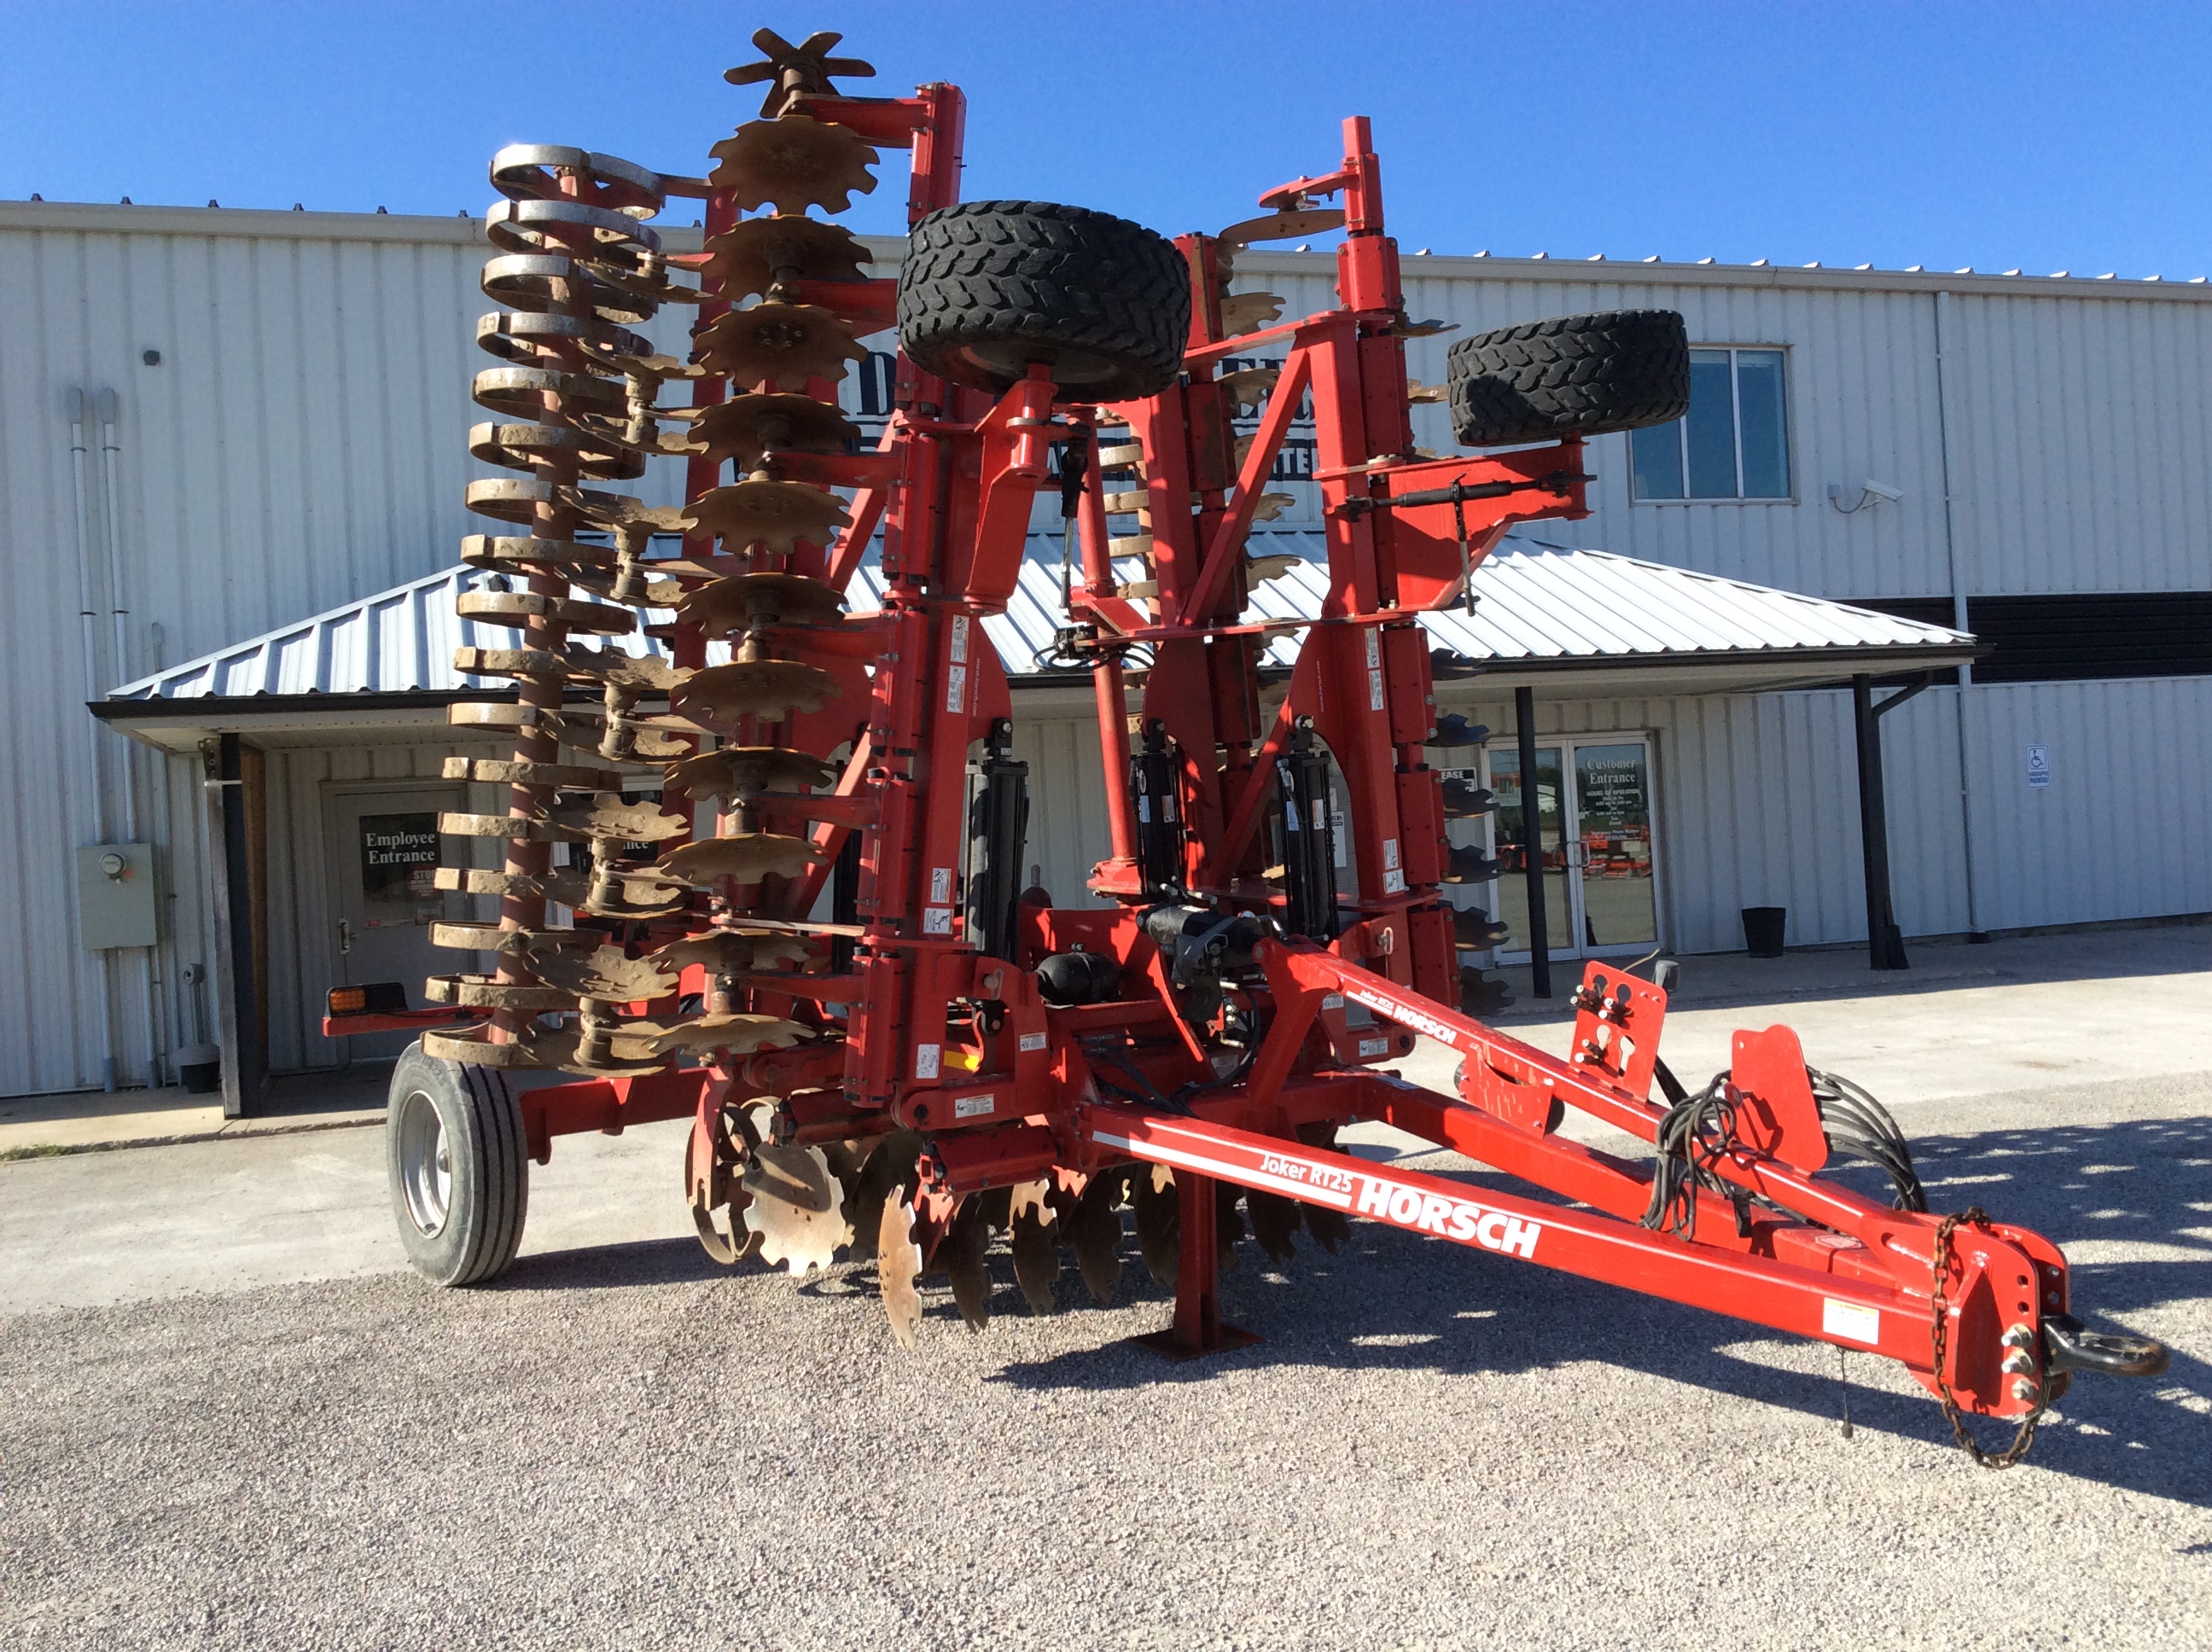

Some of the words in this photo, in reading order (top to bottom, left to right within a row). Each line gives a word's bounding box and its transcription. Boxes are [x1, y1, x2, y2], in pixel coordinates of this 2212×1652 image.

[1587, 758, 1636, 770] Customer
[1441, 771, 1464, 780] EASE
[1590, 772, 1636, 784] Entrance
[365, 831, 436, 849] Employee
[368, 850, 435, 864] Entrance
[1393, 1005, 1458, 1044] HORSCH
[1260, 1155, 1307, 1180] Joker
[1310, 1166, 1353, 1193] RT25
[1357, 1178, 1541, 1259] HORSCH
